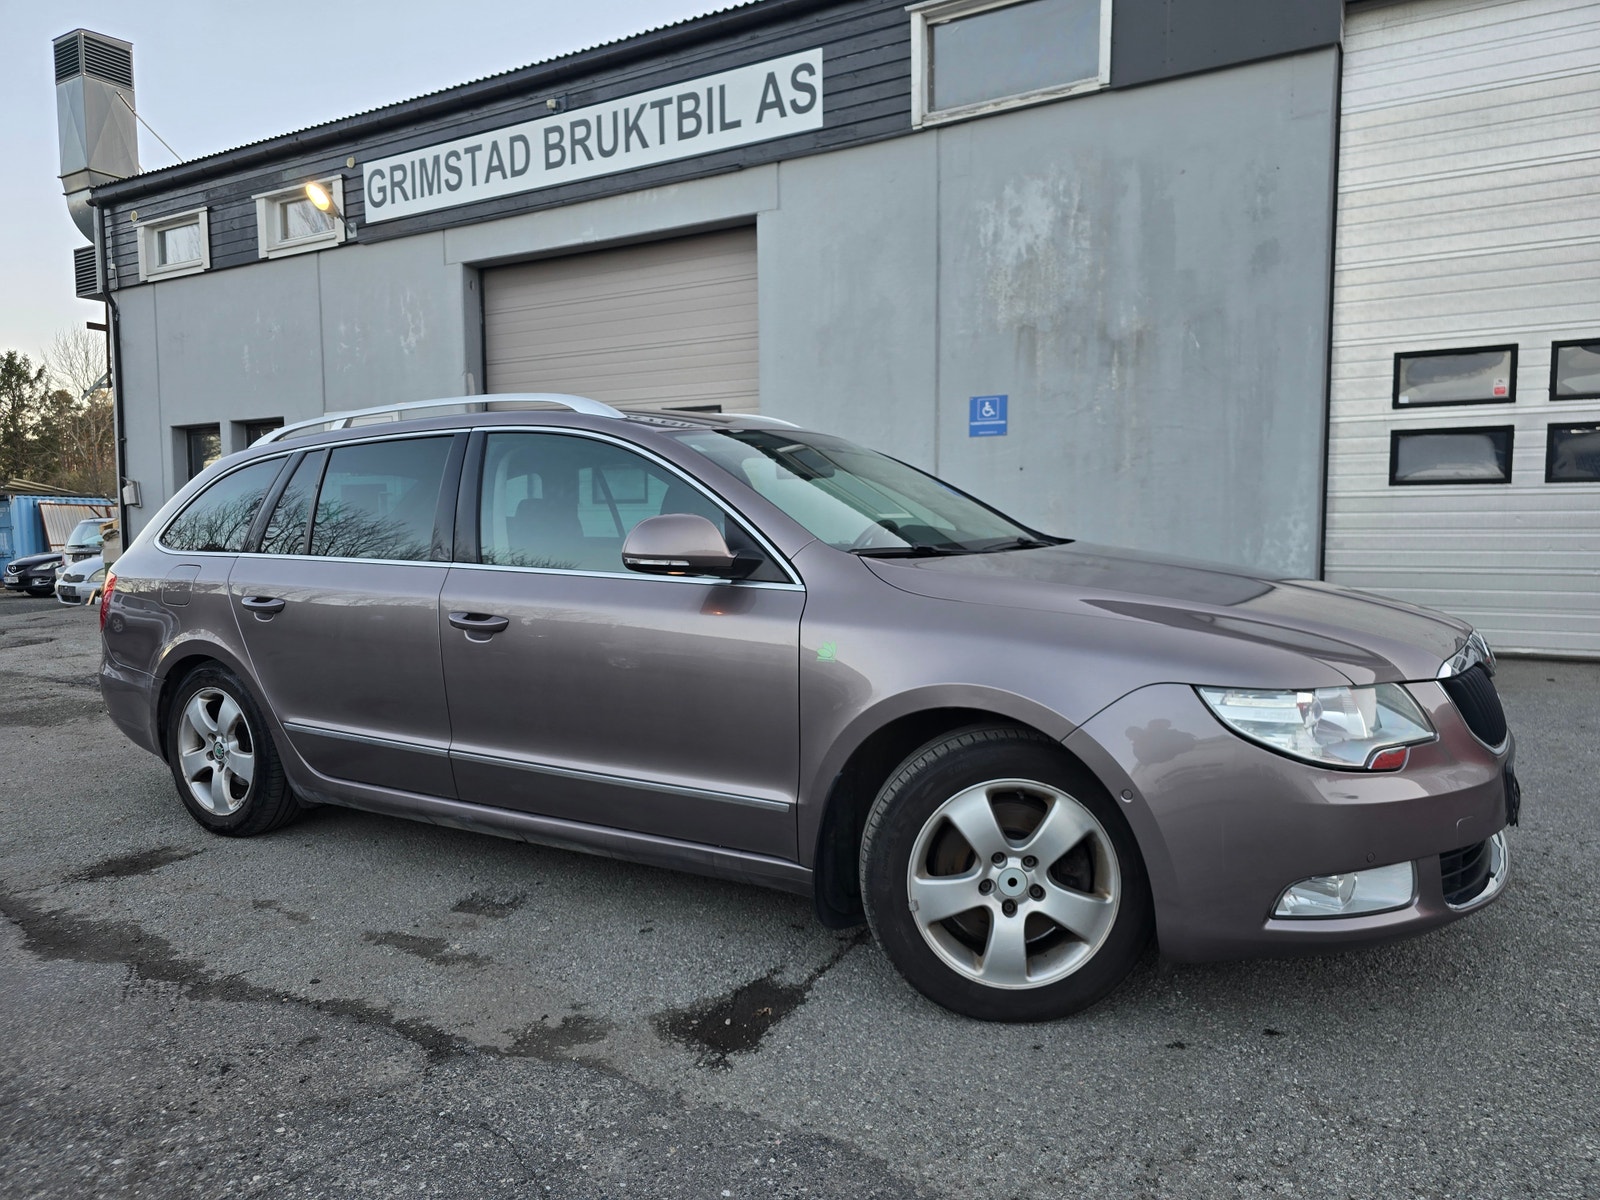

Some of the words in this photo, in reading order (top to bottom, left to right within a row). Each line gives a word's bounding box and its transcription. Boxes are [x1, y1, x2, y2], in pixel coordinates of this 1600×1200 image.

[367, 134, 531, 208] GRIMSTAD
[544, 84, 742, 170] BRUKTBIL
[756, 63, 817, 124] AS
